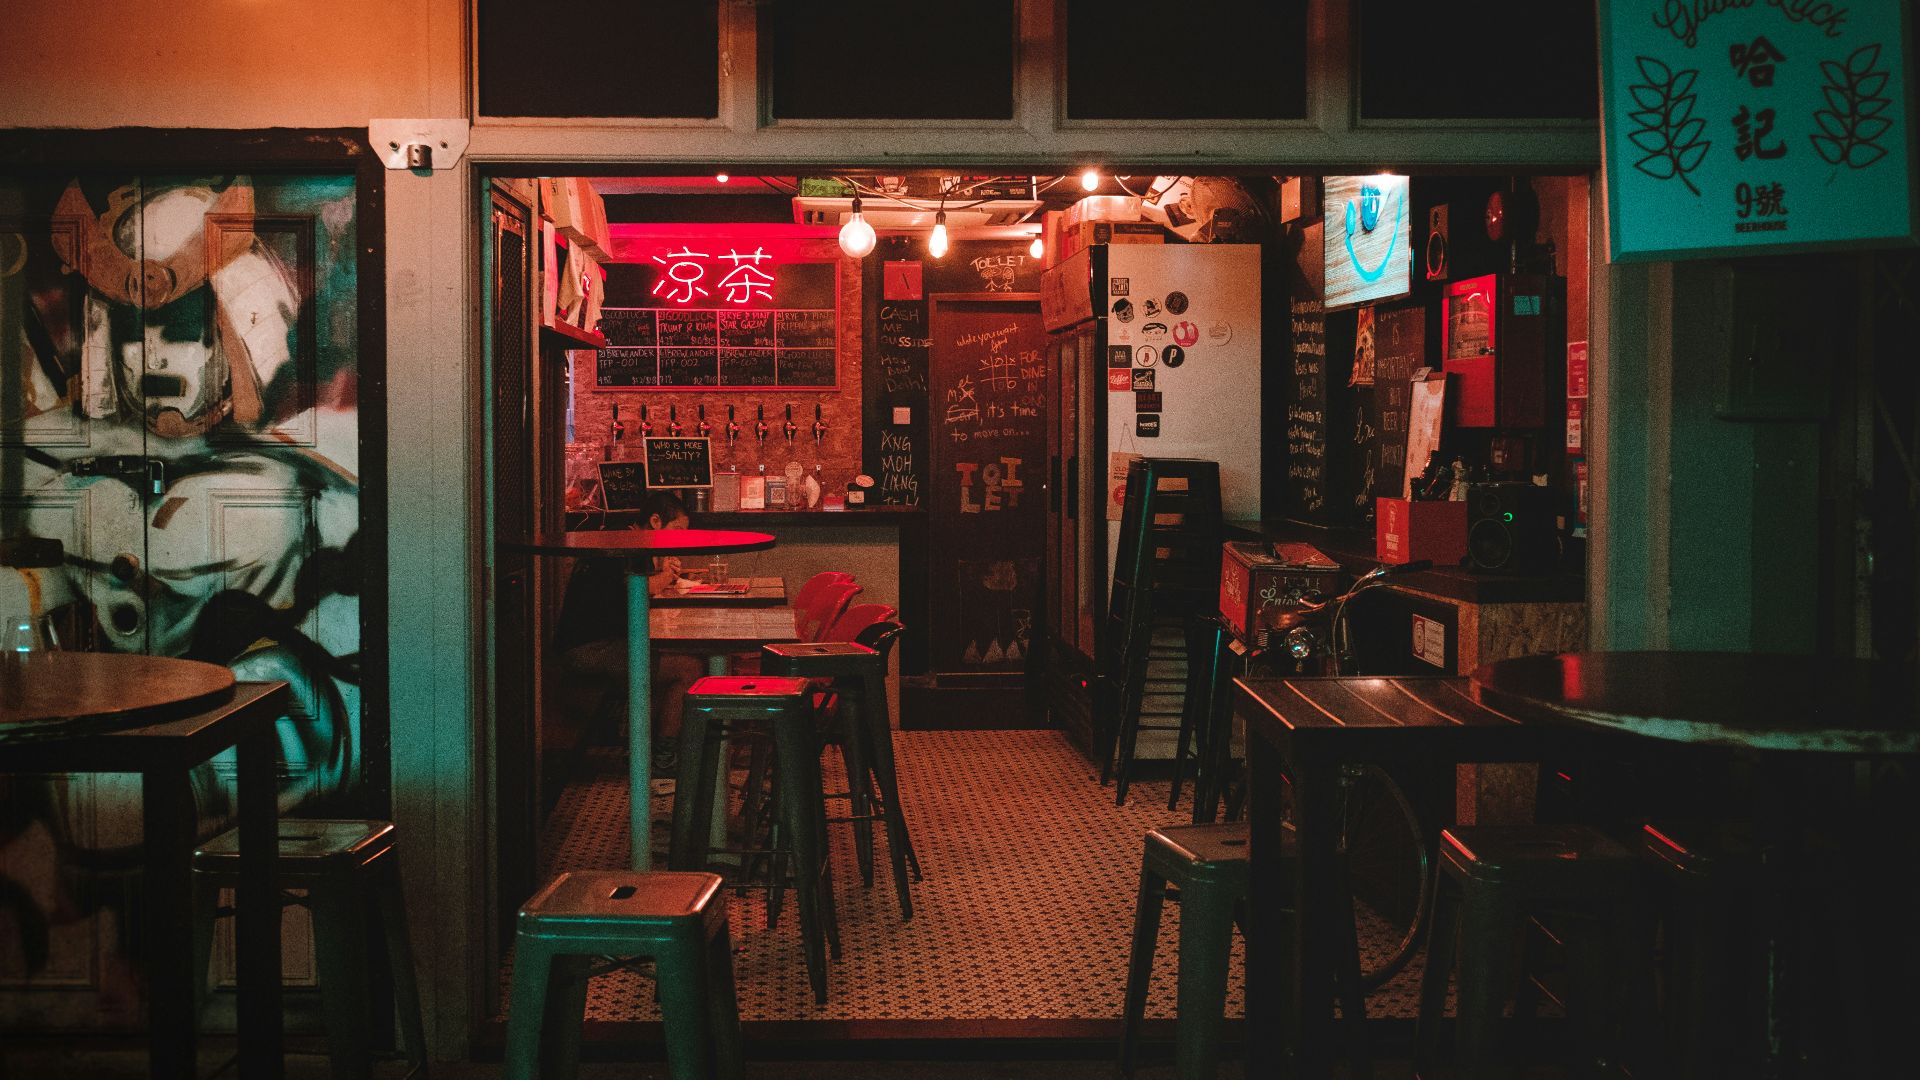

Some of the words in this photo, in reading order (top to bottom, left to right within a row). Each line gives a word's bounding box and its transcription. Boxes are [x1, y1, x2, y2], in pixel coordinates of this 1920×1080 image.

[1735, 182, 1789, 218] 9號
[880, 306, 920, 324] CASH
[883, 323, 905, 332] ME
[987, 402, 1005, 418] it's
[1010, 401, 1039, 418] time
[951, 427, 969, 443] to
[975, 429, 1000, 441] move
[653, 442, 671, 451] WHO
[684, 441, 704, 450] MORE
[956, 456, 1023, 490] TOI
[960, 482, 1024, 513] LET
